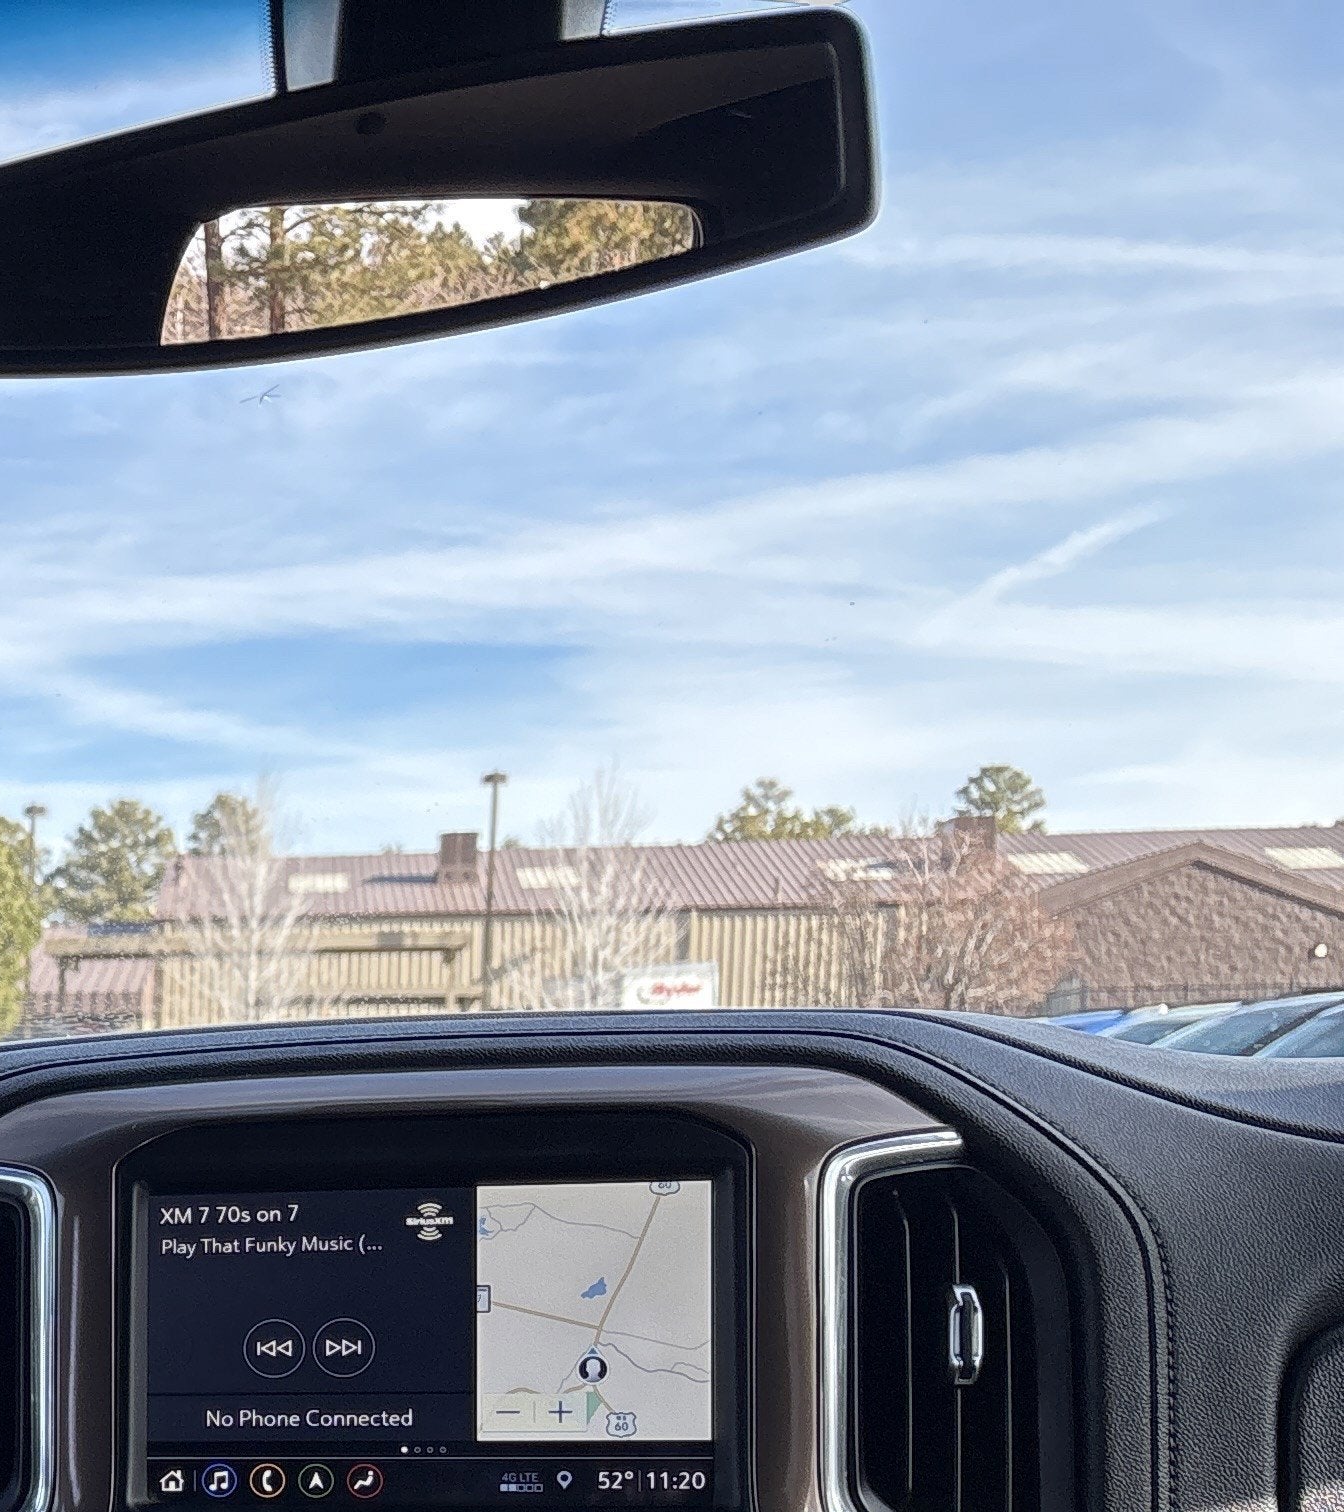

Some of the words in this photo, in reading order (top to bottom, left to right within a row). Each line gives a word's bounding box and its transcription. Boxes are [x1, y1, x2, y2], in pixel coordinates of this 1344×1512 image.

[159, 1207, 194, 1225] XM
[198, 1207, 211, 1224] 7
[216, 1206, 251, 1224] 70s
[257, 1209, 282, 1223] on
[287, 1205, 299, 1223] 7
[161, 1238, 196, 1258] Play
[200, 1238, 241, 1255] That
[246, 1237, 296, 1257] Funky
[301, 1236, 353, 1253] Music
[206, 1410, 234, 1428] No
[239, 1409, 300, 1428] Phone
[306, 1409, 413, 1427] Connected
[615, 1422, 628, 1431] 60
[502, 1473, 517, 1483] 4G
[520, 1473, 539, 1483] LTE
[598, 1470, 634, 1490] 52°
[647, 1471, 706, 1490] 11:20
